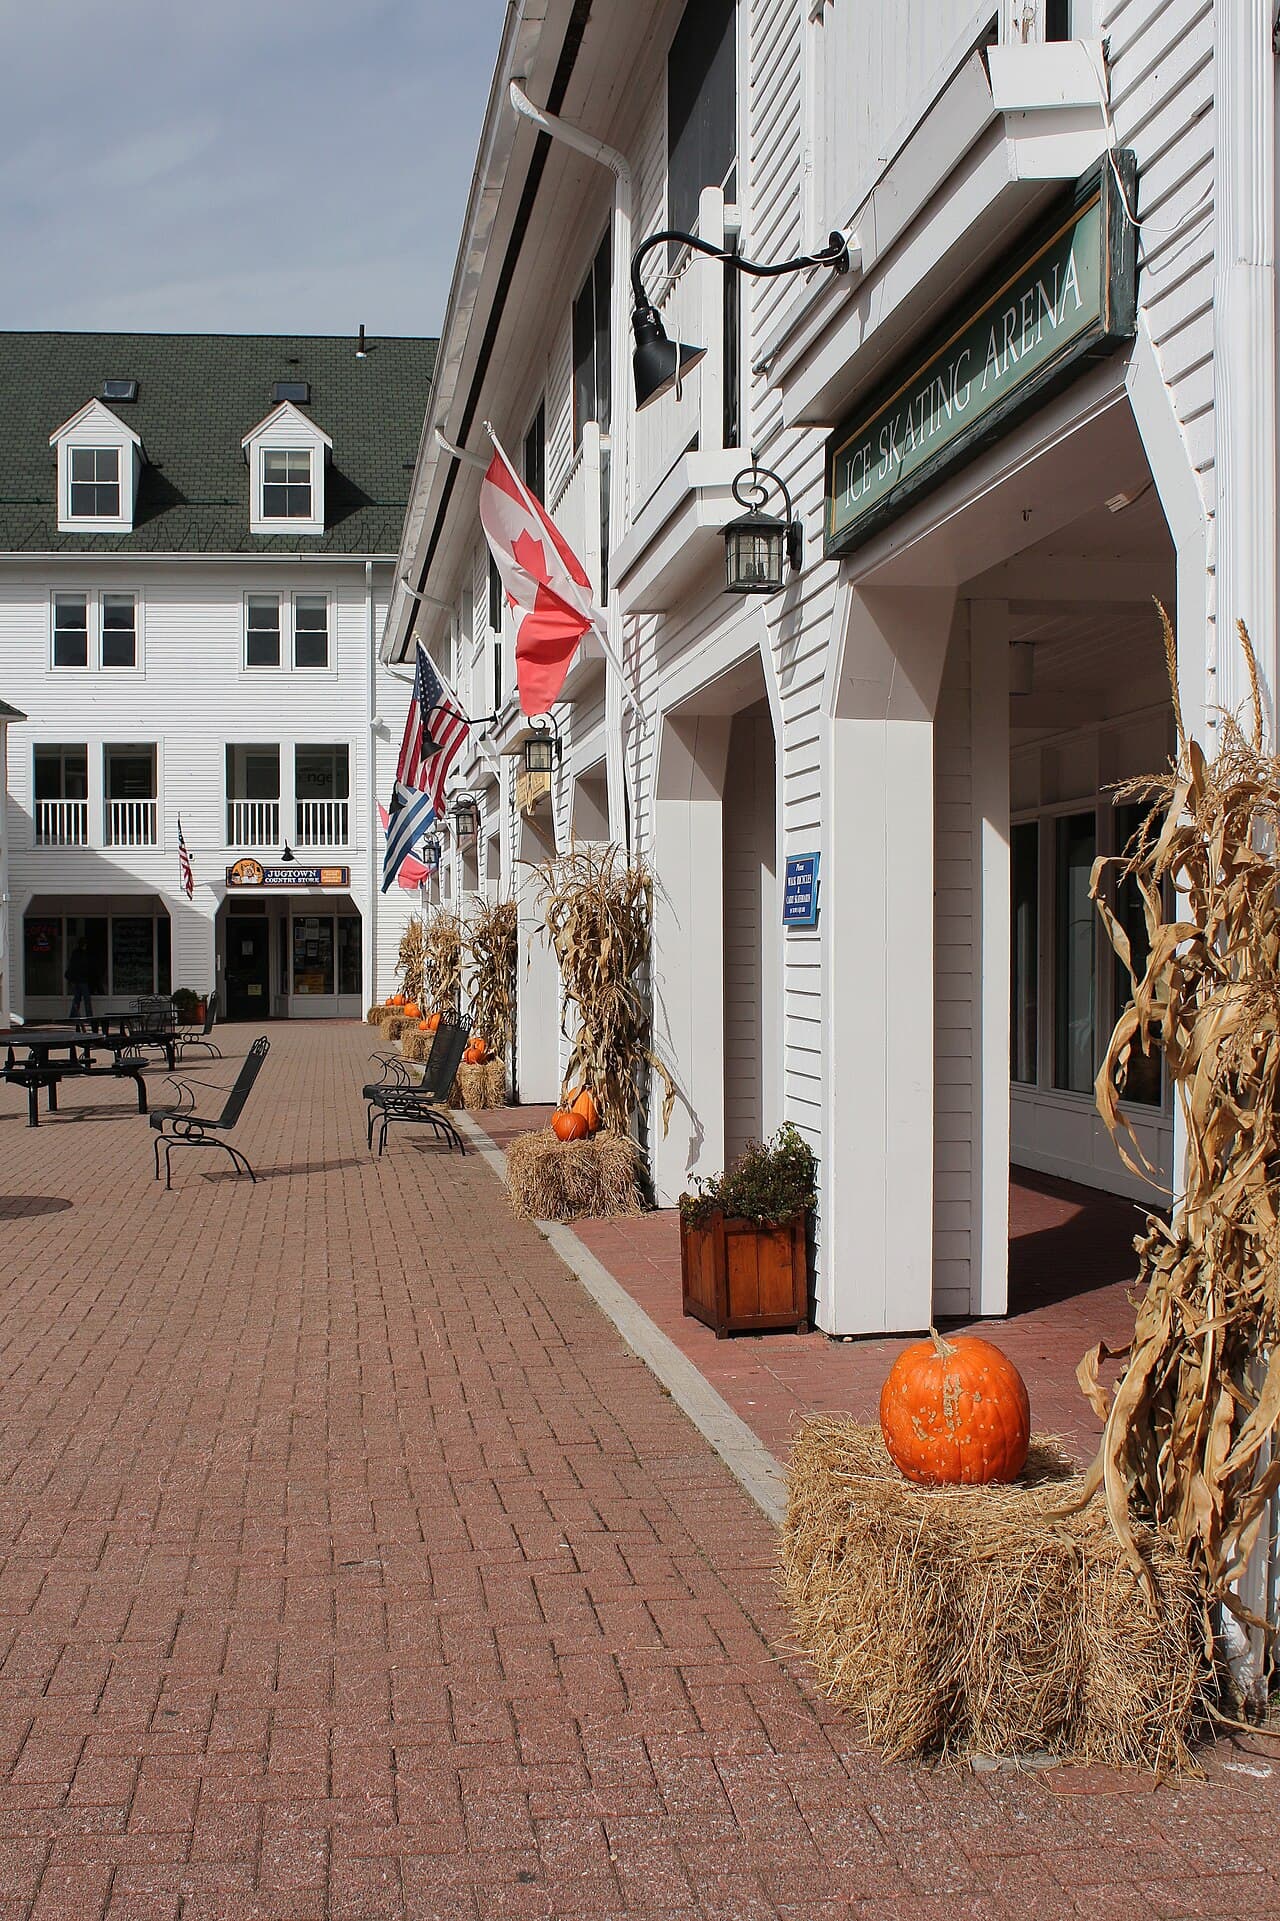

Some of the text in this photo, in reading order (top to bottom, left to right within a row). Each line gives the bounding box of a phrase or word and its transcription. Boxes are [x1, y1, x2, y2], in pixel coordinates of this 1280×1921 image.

[843, 246, 1084, 509] ICE SKATING ARENA
[267, 869, 317, 878] JUGTOWN
